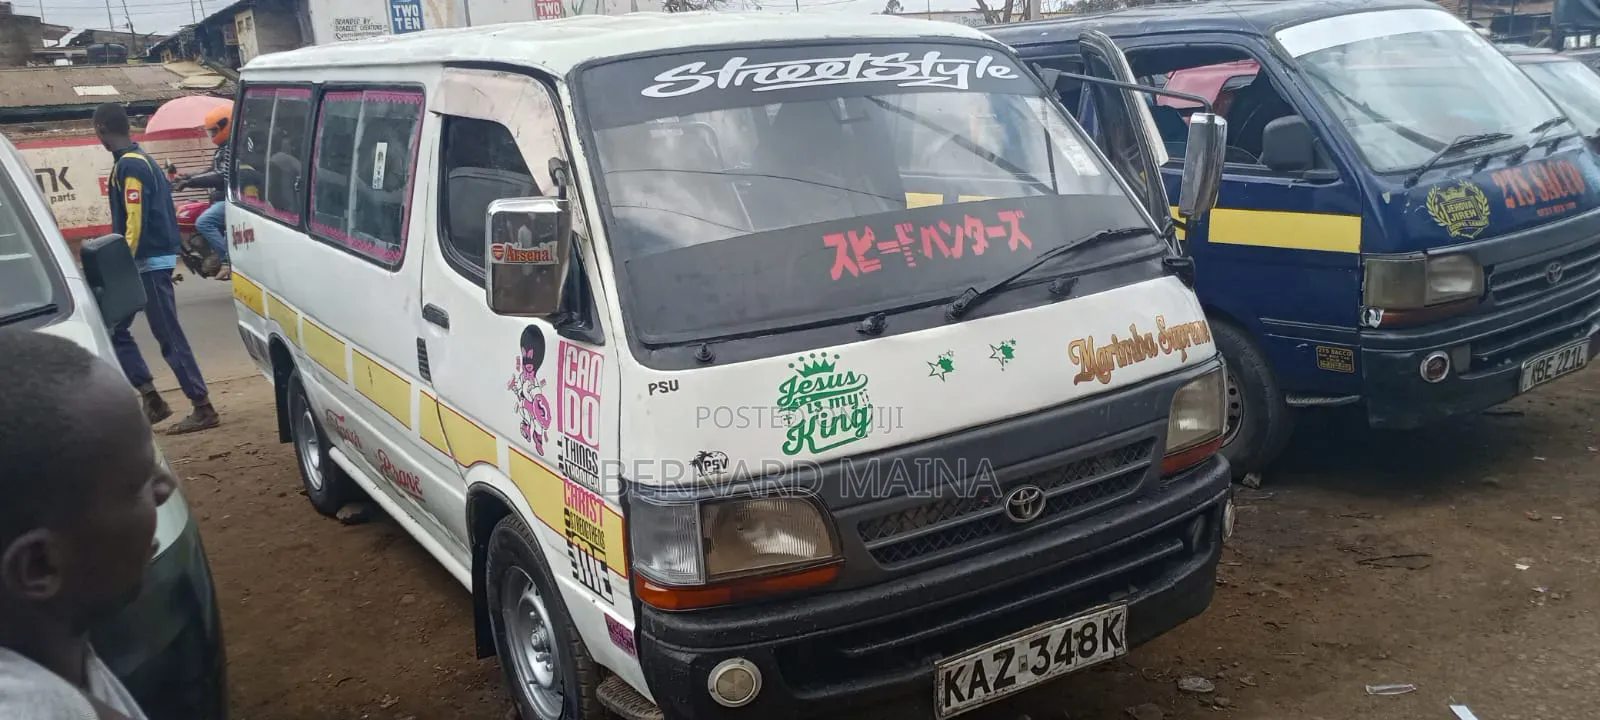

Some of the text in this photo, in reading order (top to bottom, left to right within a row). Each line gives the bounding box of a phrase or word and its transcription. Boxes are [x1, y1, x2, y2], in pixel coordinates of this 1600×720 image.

[393, 4, 419, 17] TWO
[394, 17, 420, 31] TEN
[536, 3, 560, 16] TWO
[1527, 160, 1585, 202] SACCO
[50, 193, 76, 205] parts
[1450, 209, 1478, 223] JIREH
[505, 243, 556, 262] Arsenal
[822, 209, 1033, 281] スピードハンターズ
[564, 345, 604, 397] CAN
[1068, 322, 1159, 386] Marimba
[1529, 355, 1555, 385] KBE
[648, 379, 680, 397] PSU
[777, 370, 869, 410] Jesus
[808, 392, 861, 414] is my
[563, 387, 601, 448] DO
[782, 404, 874, 456] King
[564, 436, 599, 475] THINGS
[703, 458, 729, 472] PSV
[563, 478, 605, 527] CHRIST
[944, 612, 1123, 708] KAZ 348K
